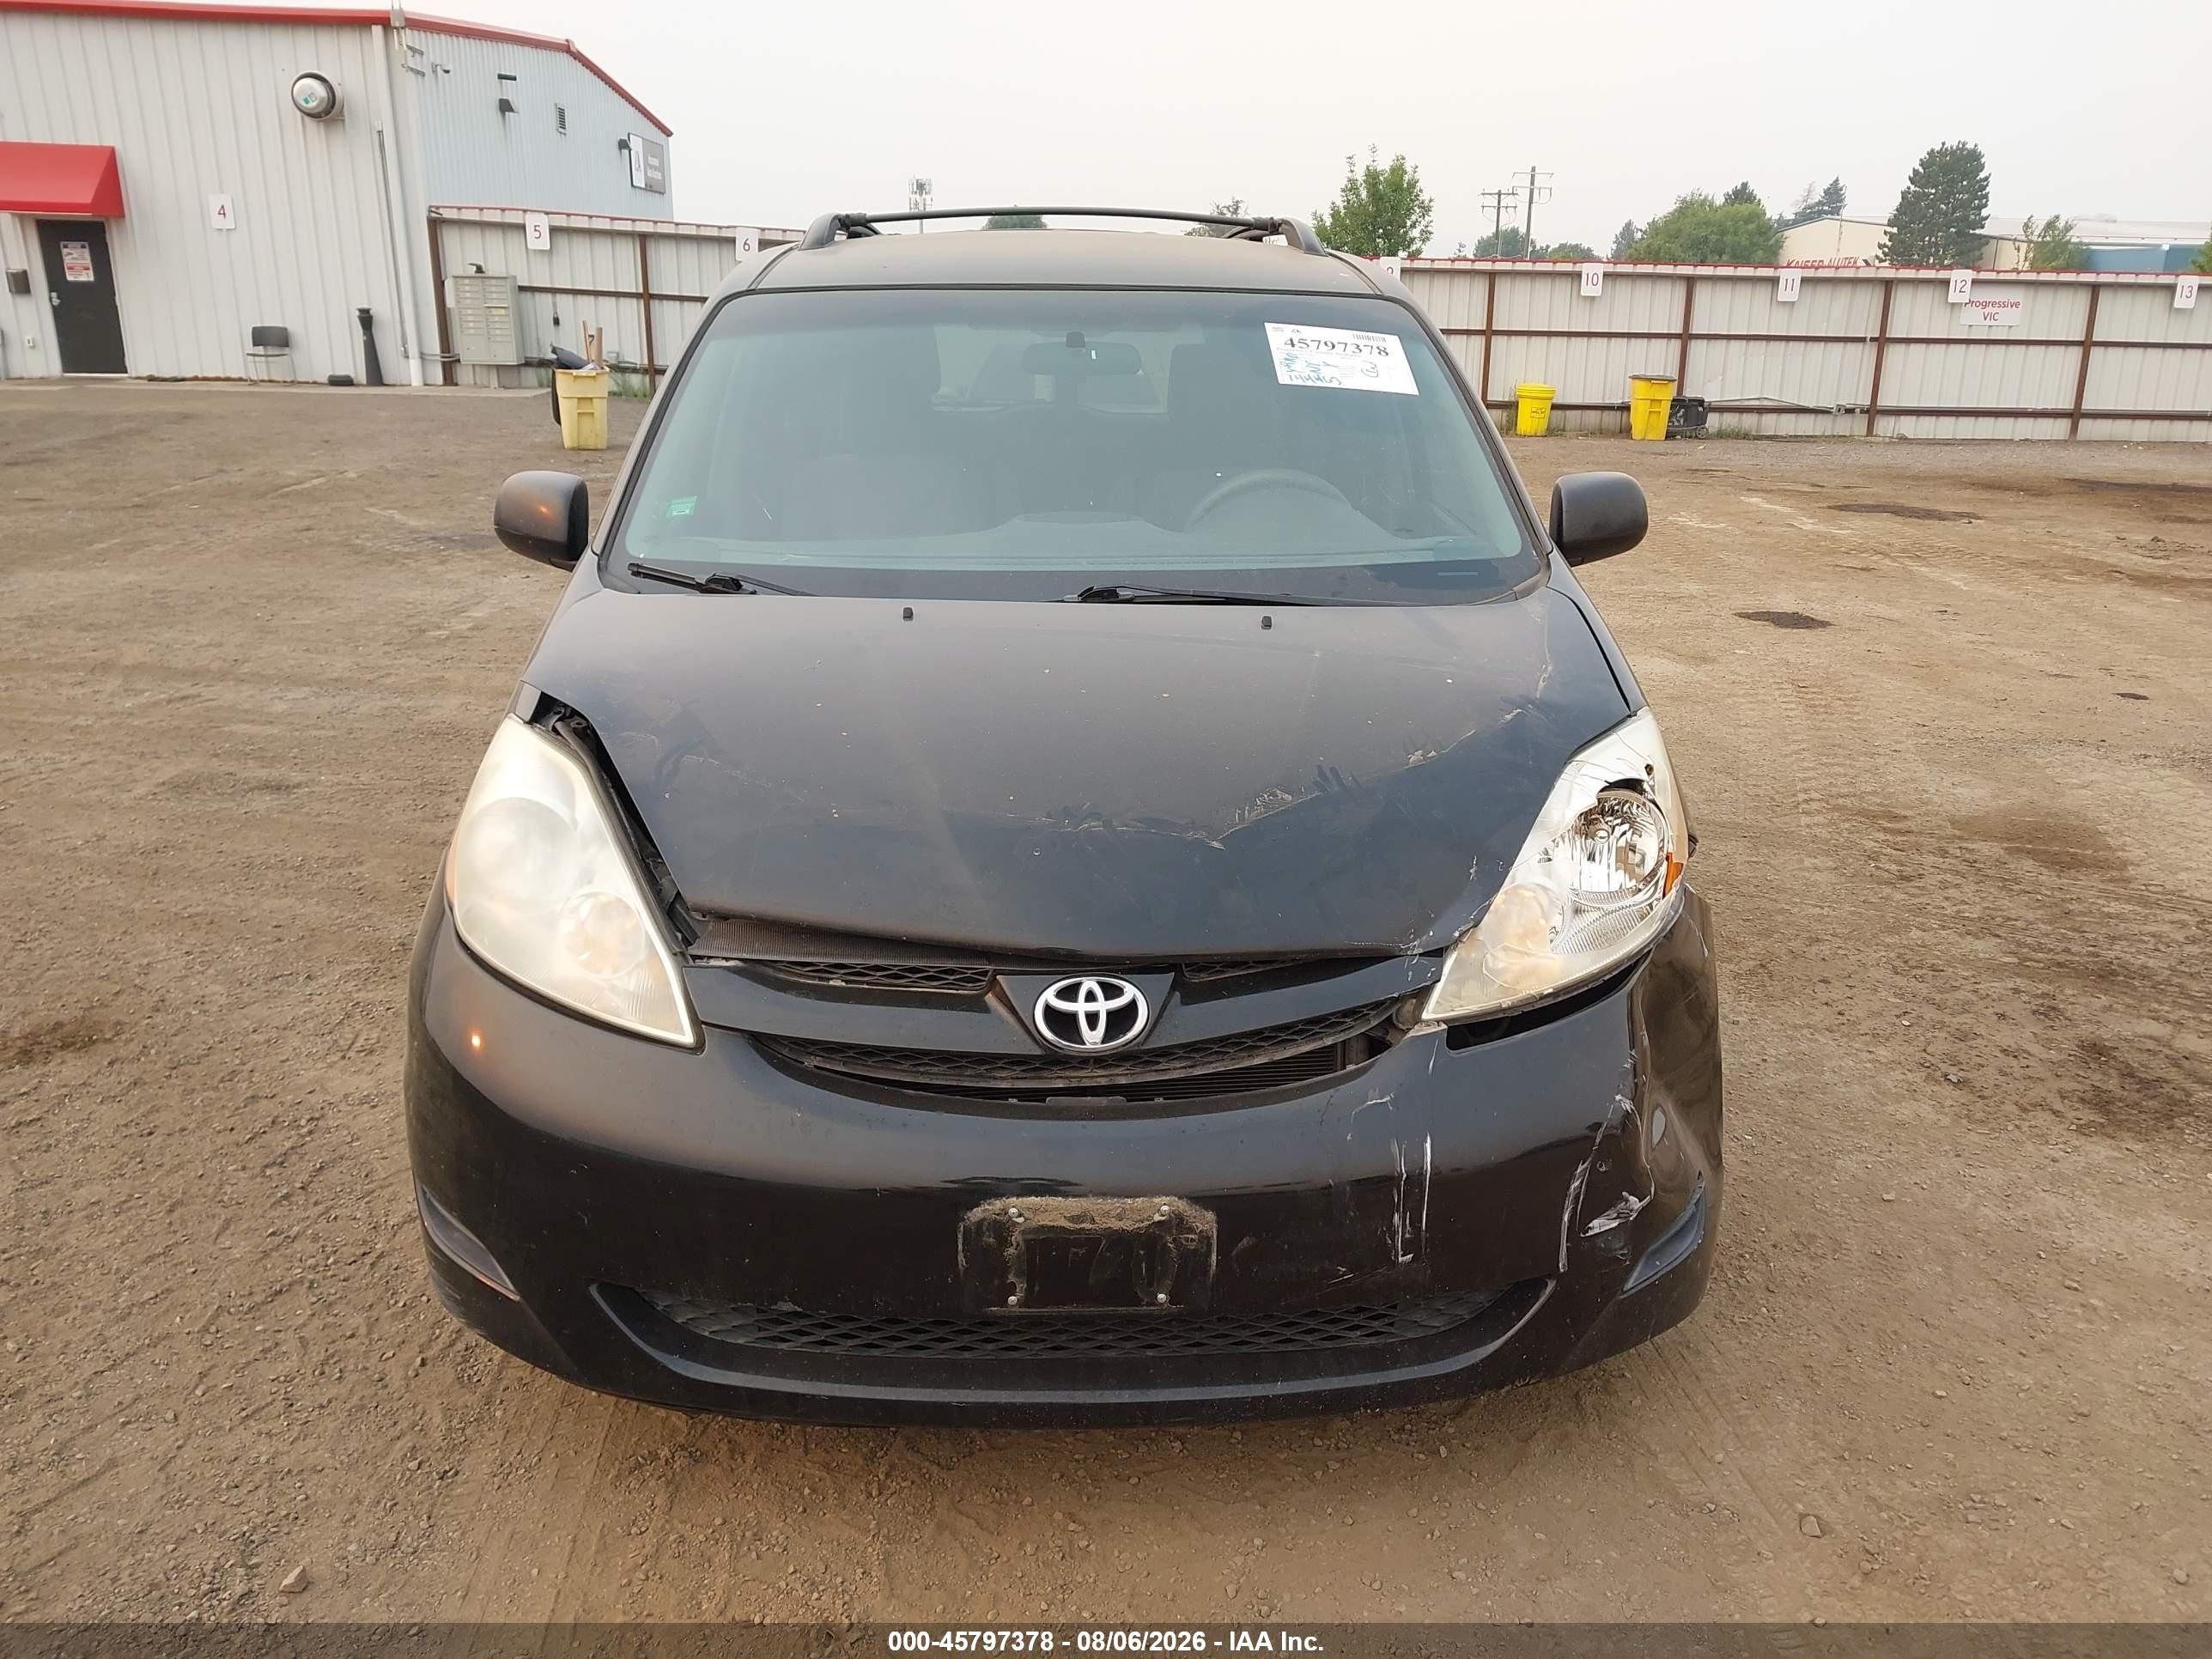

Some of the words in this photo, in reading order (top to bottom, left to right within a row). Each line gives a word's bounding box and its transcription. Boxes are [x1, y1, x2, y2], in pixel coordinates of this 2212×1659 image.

[217, 204, 227, 220] 4
[533, 224, 542, 240] 5
[743, 237, 750, 252] 6
[1585, 271, 1600, 287] 10
[1784, 276, 1796, 293] 11
[1953, 278, 1968, 294] 12
[2179, 284, 2194, 299] 13
[1983, 311, 2000, 321] VIC
[1284, 337, 1389, 357] 45797378
